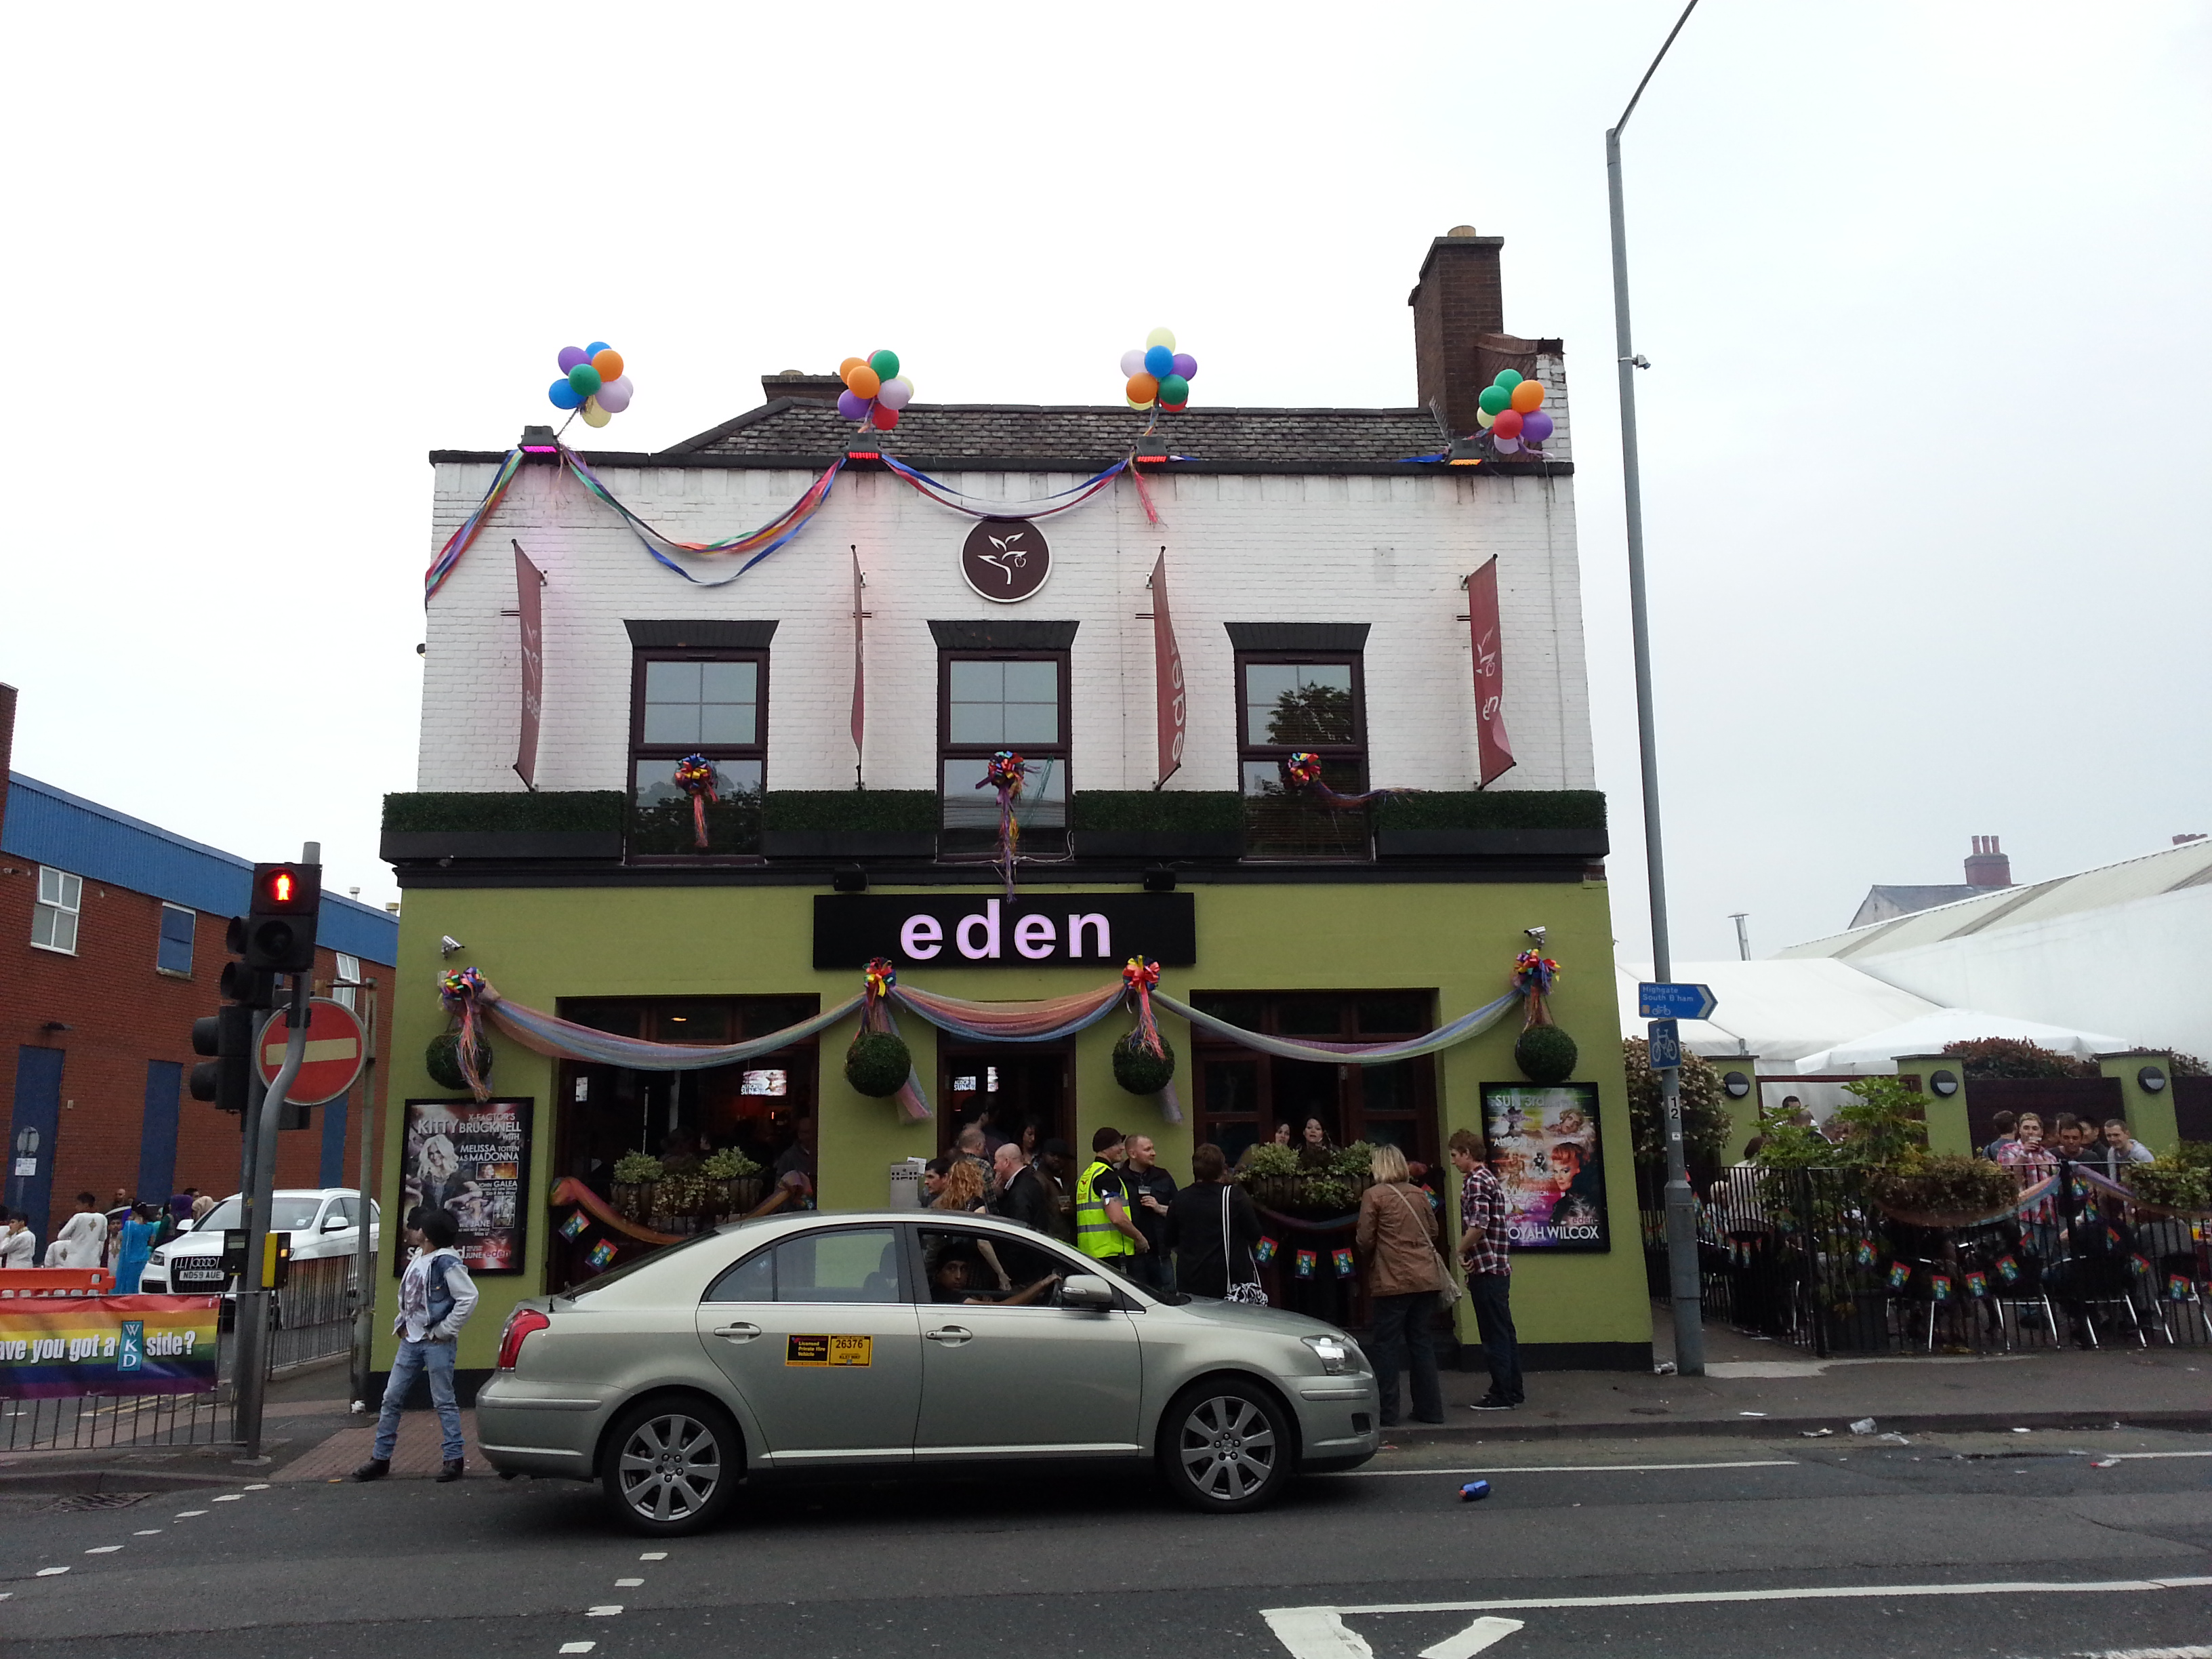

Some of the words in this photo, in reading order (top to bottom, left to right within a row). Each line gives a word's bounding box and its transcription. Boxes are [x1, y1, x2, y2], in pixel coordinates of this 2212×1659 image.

[900, 899, 1111, 960] eden
[1495, 1095, 1521, 1107] SUN
[1525, 1095, 1544, 1107] 3rd
[468, 1113, 515, 1122] X-FACTOR'S
[417, 1118, 459, 1134] KITTY
[459, 1122, 521, 1133] BRUCKNELL
[461, 1145, 495, 1153] MELISSA
[470, 1152, 518, 1161] MADONNA
[1508, 1227, 1544, 1240] OYAH
[1547, 1225, 1599, 1240] WILCOX
[485, 1250, 511, 1258] eden
[594, 1247, 610, 1264] WKD
[1259, 1242, 1271, 1261] WKD
[1302, 1255, 1311, 1274] WKD
[1338, 1254, 1348, 1273] WKD
[183, 1271, 204, 1279] ND59
[205, 1271, 222, 1279] AUE
[30, 1338, 66, 1364] you
[69, 1334, 100, 1362] got
[104, 1337, 116, 1357] a
[121, 1324, 140, 1368] WKD
[146, 1330, 196, 1357] side?
[836, 1339, 863, 1348] 26376
